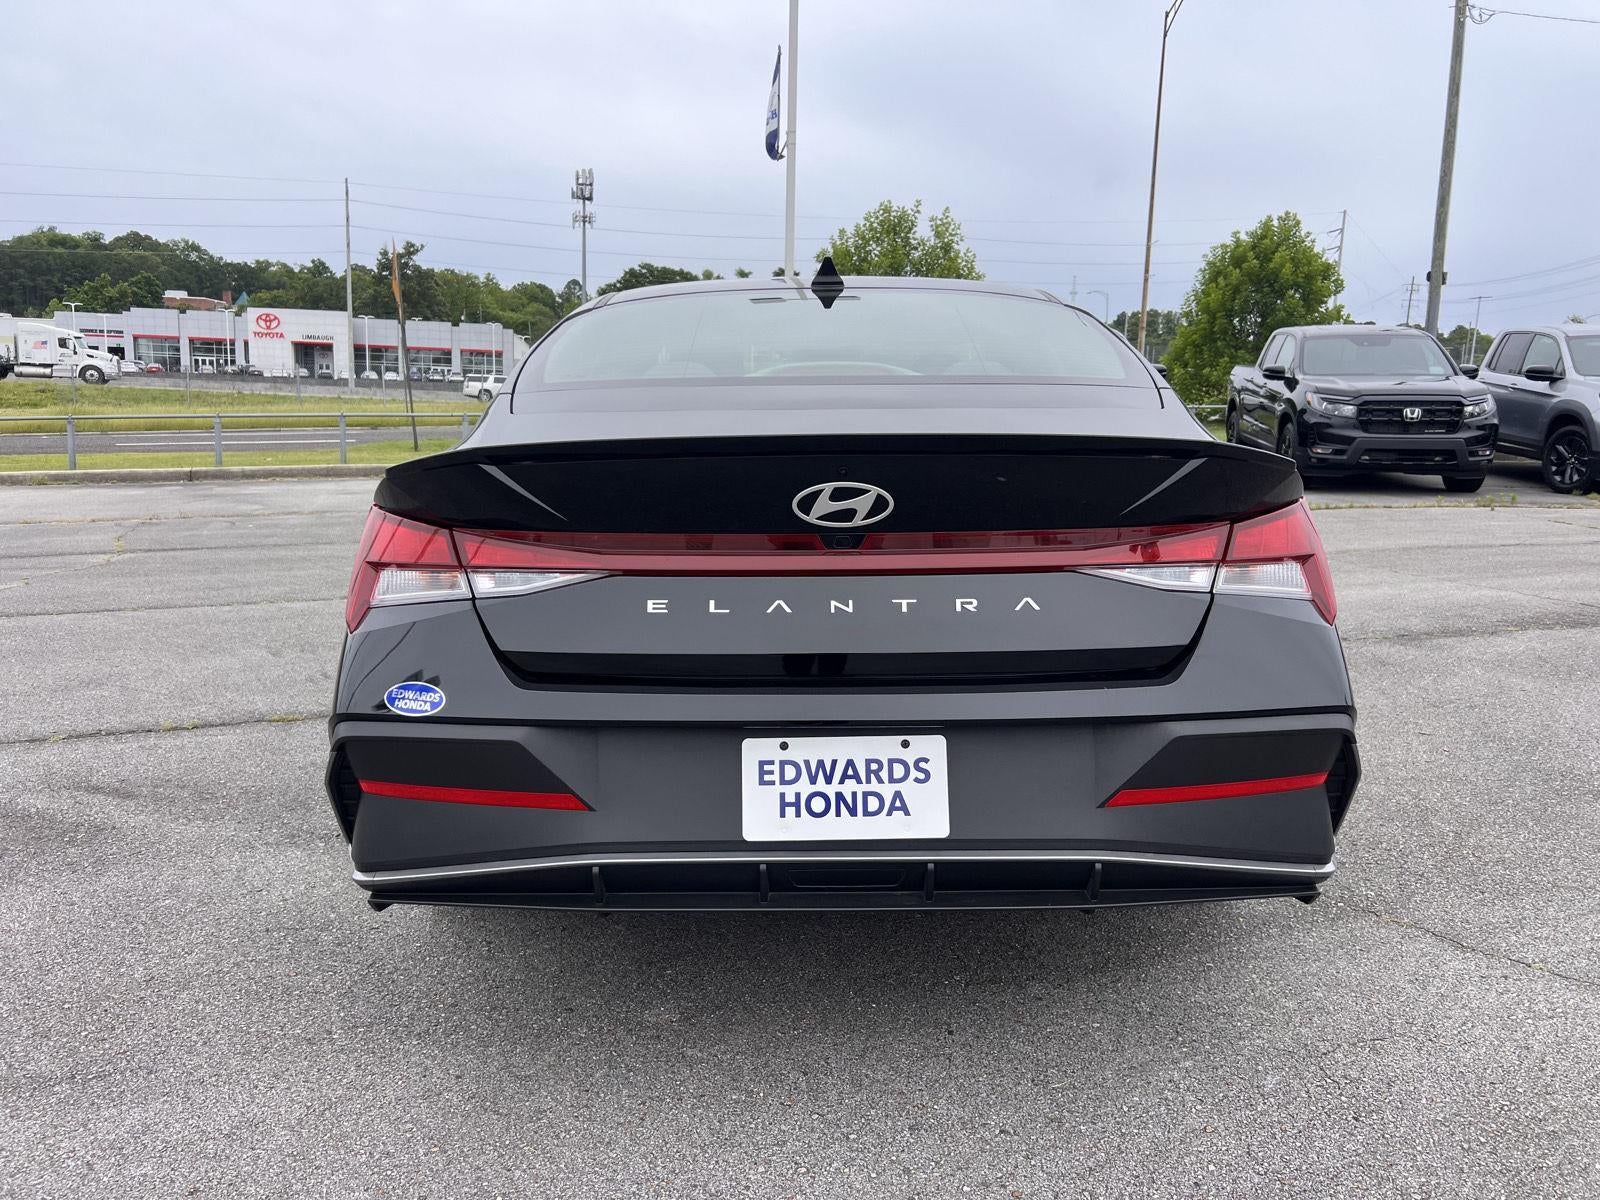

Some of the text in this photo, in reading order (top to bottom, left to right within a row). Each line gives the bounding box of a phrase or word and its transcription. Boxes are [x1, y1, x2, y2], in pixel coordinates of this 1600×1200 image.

[252, 331, 285, 339] TOYOTA
[647, 597, 1040, 614] ELANTRA
[391, 688, 441, 702] EDWARDS
[394, 698, 431, 712] HONDA
[758, 757, 931, 786] EDWARDS
[779, 790, 911, 818] HONDA
